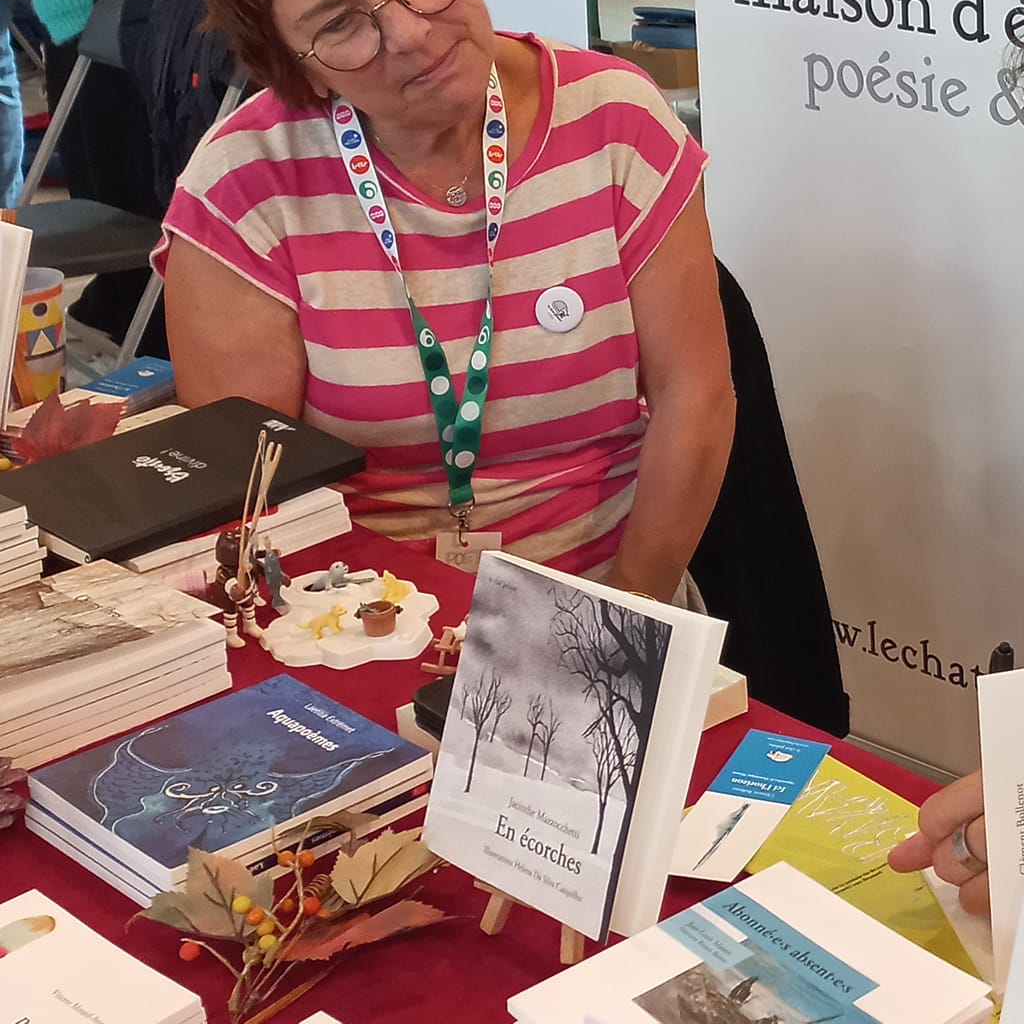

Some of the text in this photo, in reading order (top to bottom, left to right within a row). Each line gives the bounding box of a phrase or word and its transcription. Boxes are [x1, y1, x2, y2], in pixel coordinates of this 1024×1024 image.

[803, 50, 971, 118] poésie
[495, 814, 582, 875] En écorches
